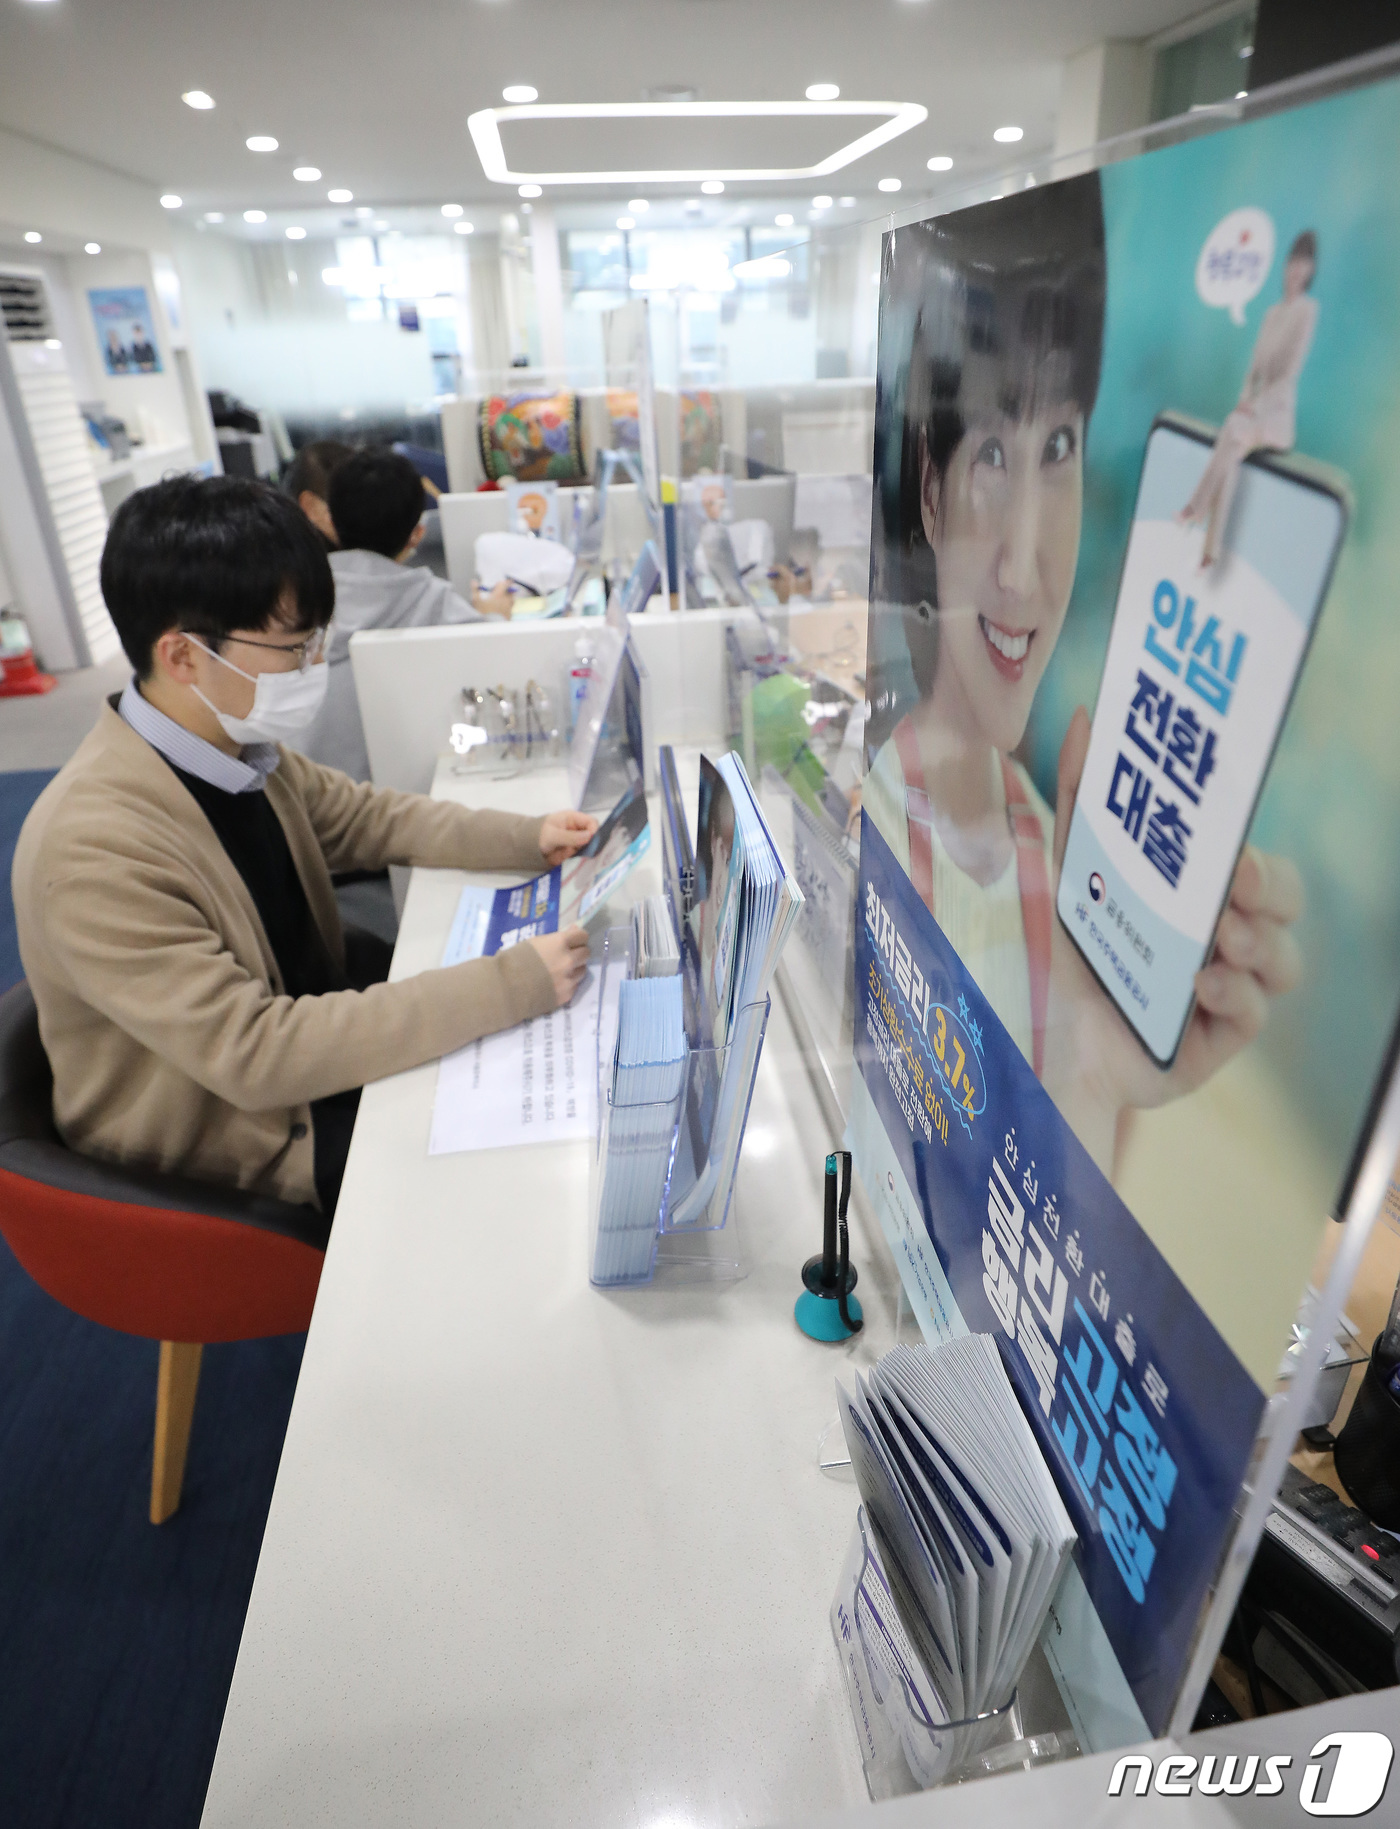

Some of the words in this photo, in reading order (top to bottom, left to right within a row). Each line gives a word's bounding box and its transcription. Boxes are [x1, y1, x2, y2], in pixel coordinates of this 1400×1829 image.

[1143, 578, 1249, 718] 안심
[1125, 669, 1221, 806] 전환
[1106, 750, 1195, 890] 대출
[866, 882, 930, 1035] 최저금리
[934, 1007, 976, 1122] 3.7%
[925, 1077, 949, 1147] 없이!
